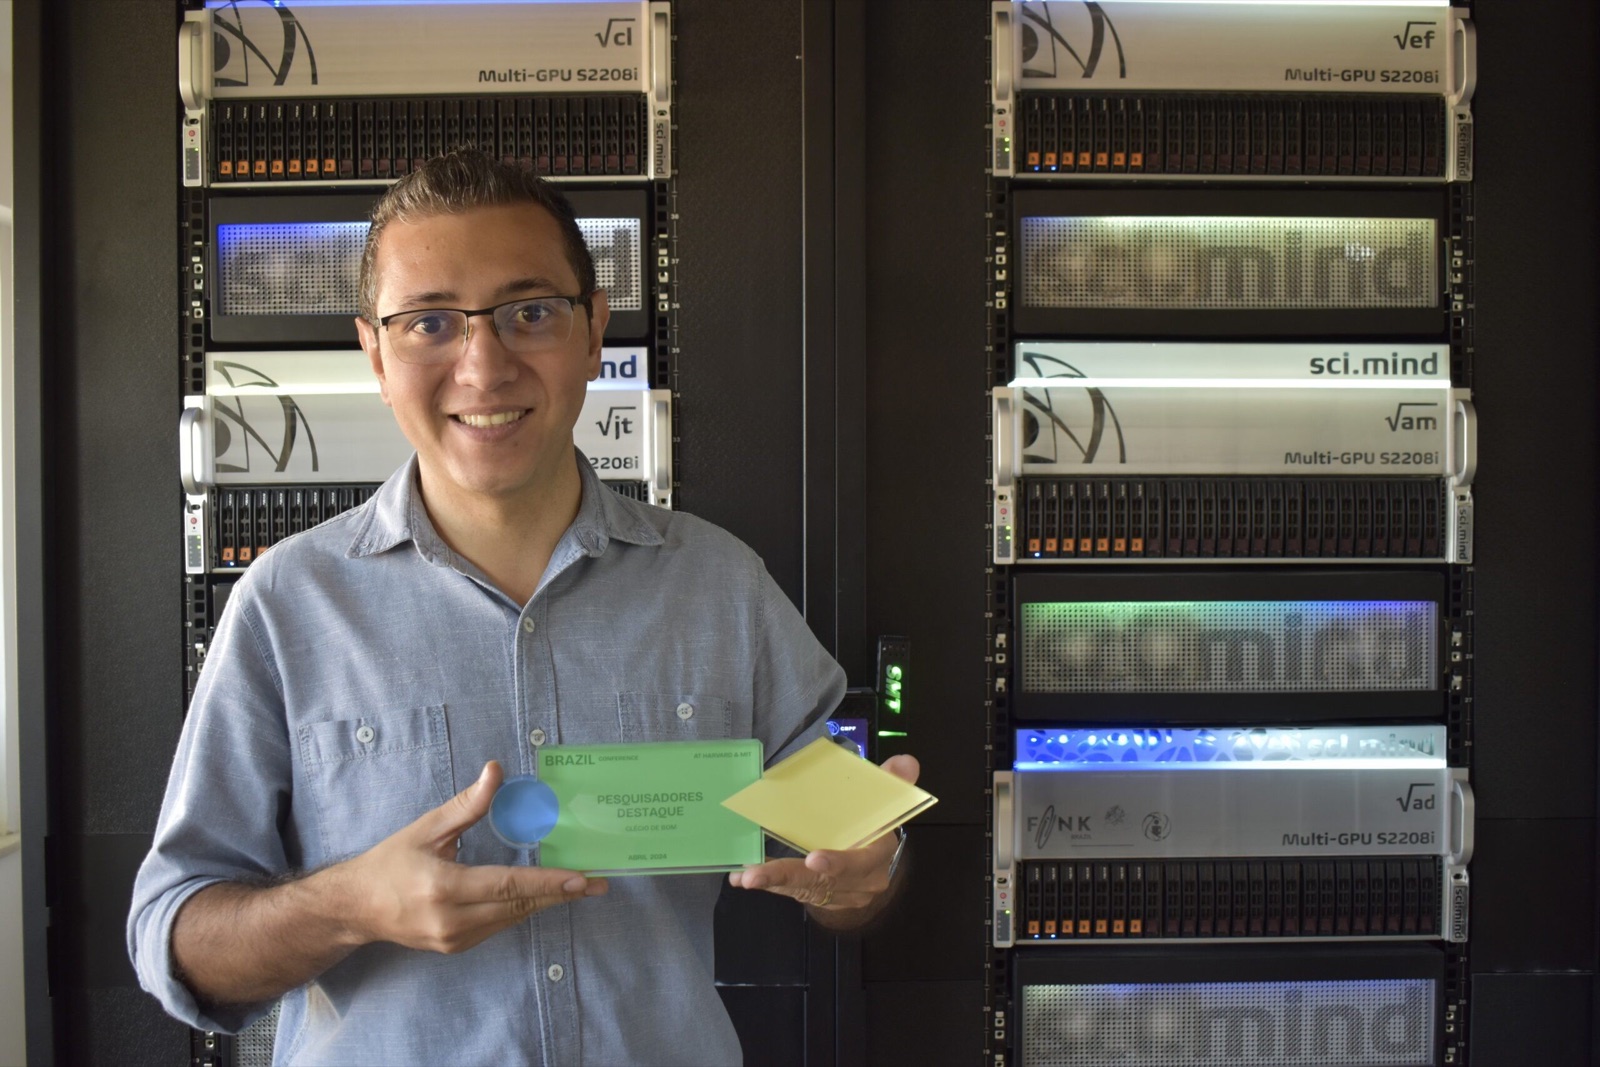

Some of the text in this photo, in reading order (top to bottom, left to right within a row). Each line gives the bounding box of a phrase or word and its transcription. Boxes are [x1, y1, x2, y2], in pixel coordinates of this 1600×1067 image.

[478, 67, 638, 83] Multi-GPU S2208i
[1285, 68, 1439, 83] Multi-GPU S2208i
[655, 122, 666, 175] sci.mind
[1459, 124, 1469, 177] sci.mind
[1310, 352, 1438, 375] sci.mind
[589, 456, 639, 469] 2208i
[1284, 451, 1439, 465] Multi-GPU S2208i
[1458, 508, 1469, 560] sci.mind
[545, 754, 595, 766] BRAZIL
[597, 791, 704, 806] PESQUISADORES
[617, 806, 684, 818] DESTAQUE
[1282, 831, 1435, 846] Multi-GPU S2208i
[1454, 888, 1466, 939] sci.mind
